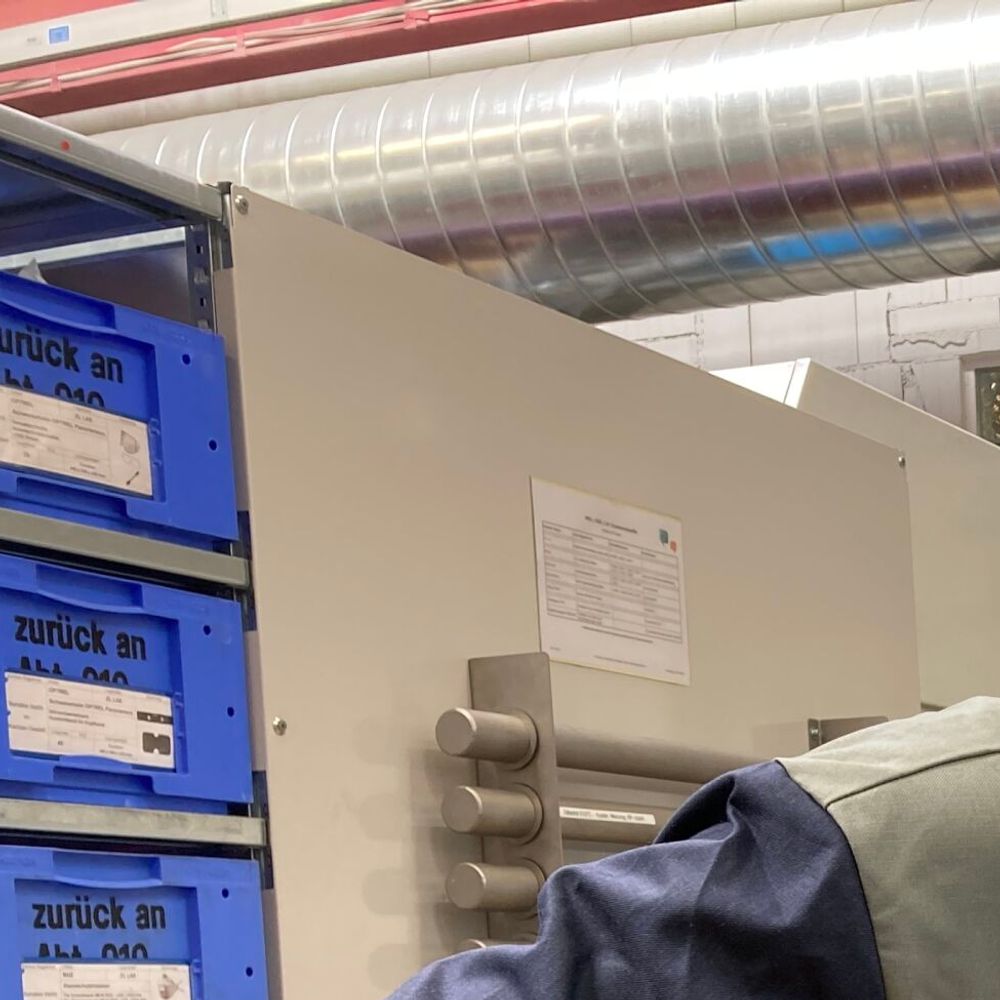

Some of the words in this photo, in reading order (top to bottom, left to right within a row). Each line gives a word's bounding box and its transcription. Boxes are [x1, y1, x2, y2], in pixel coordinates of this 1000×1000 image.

[0, 324, 80, 373] urück
[90, 352, 124, 384] an
[14, 613, 107, 656] zurück
[116, 632, 147, 661] an
[31, 895, 126, 930] zurück
[135, 903, 167, 930] an
